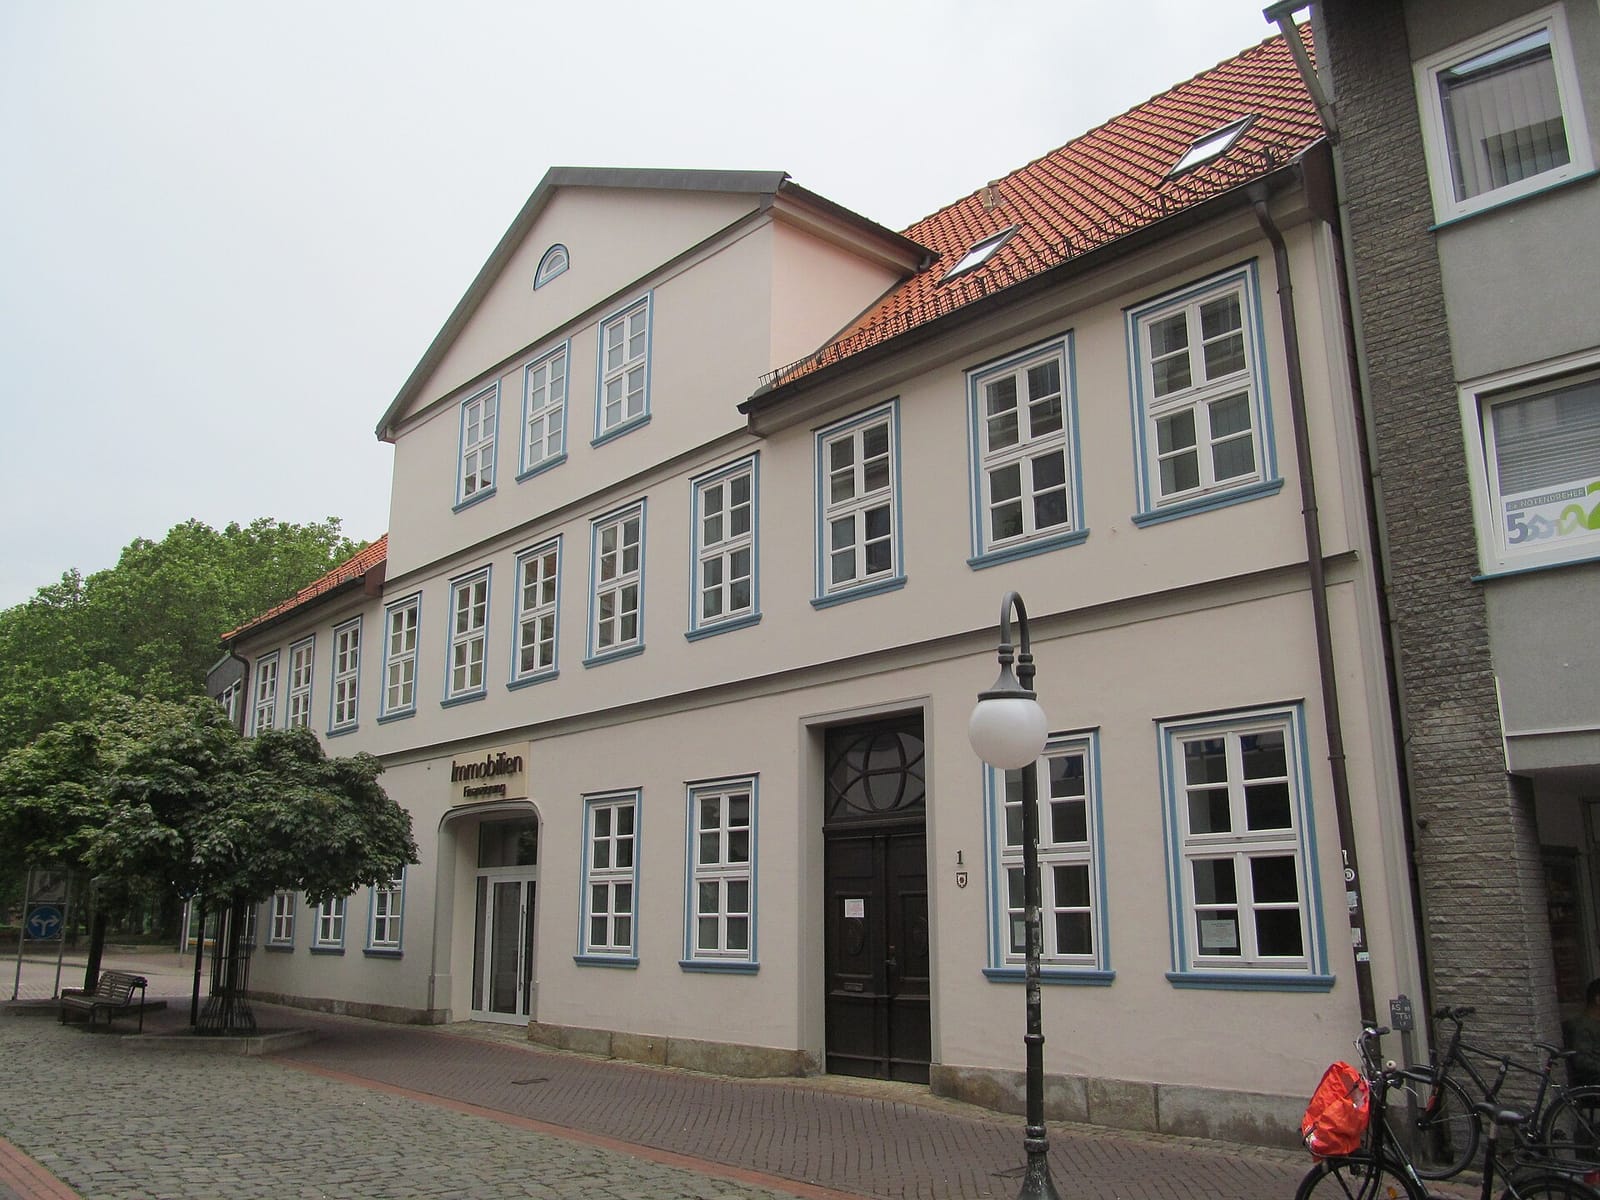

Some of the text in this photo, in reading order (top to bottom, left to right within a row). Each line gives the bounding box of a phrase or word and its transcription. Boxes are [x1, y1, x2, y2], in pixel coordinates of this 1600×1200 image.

[1520, 488, 1585, 507] NOTENDREHER
[451, 752, 523, 782] Immobilien
[956, 849, 964, 865] 1
